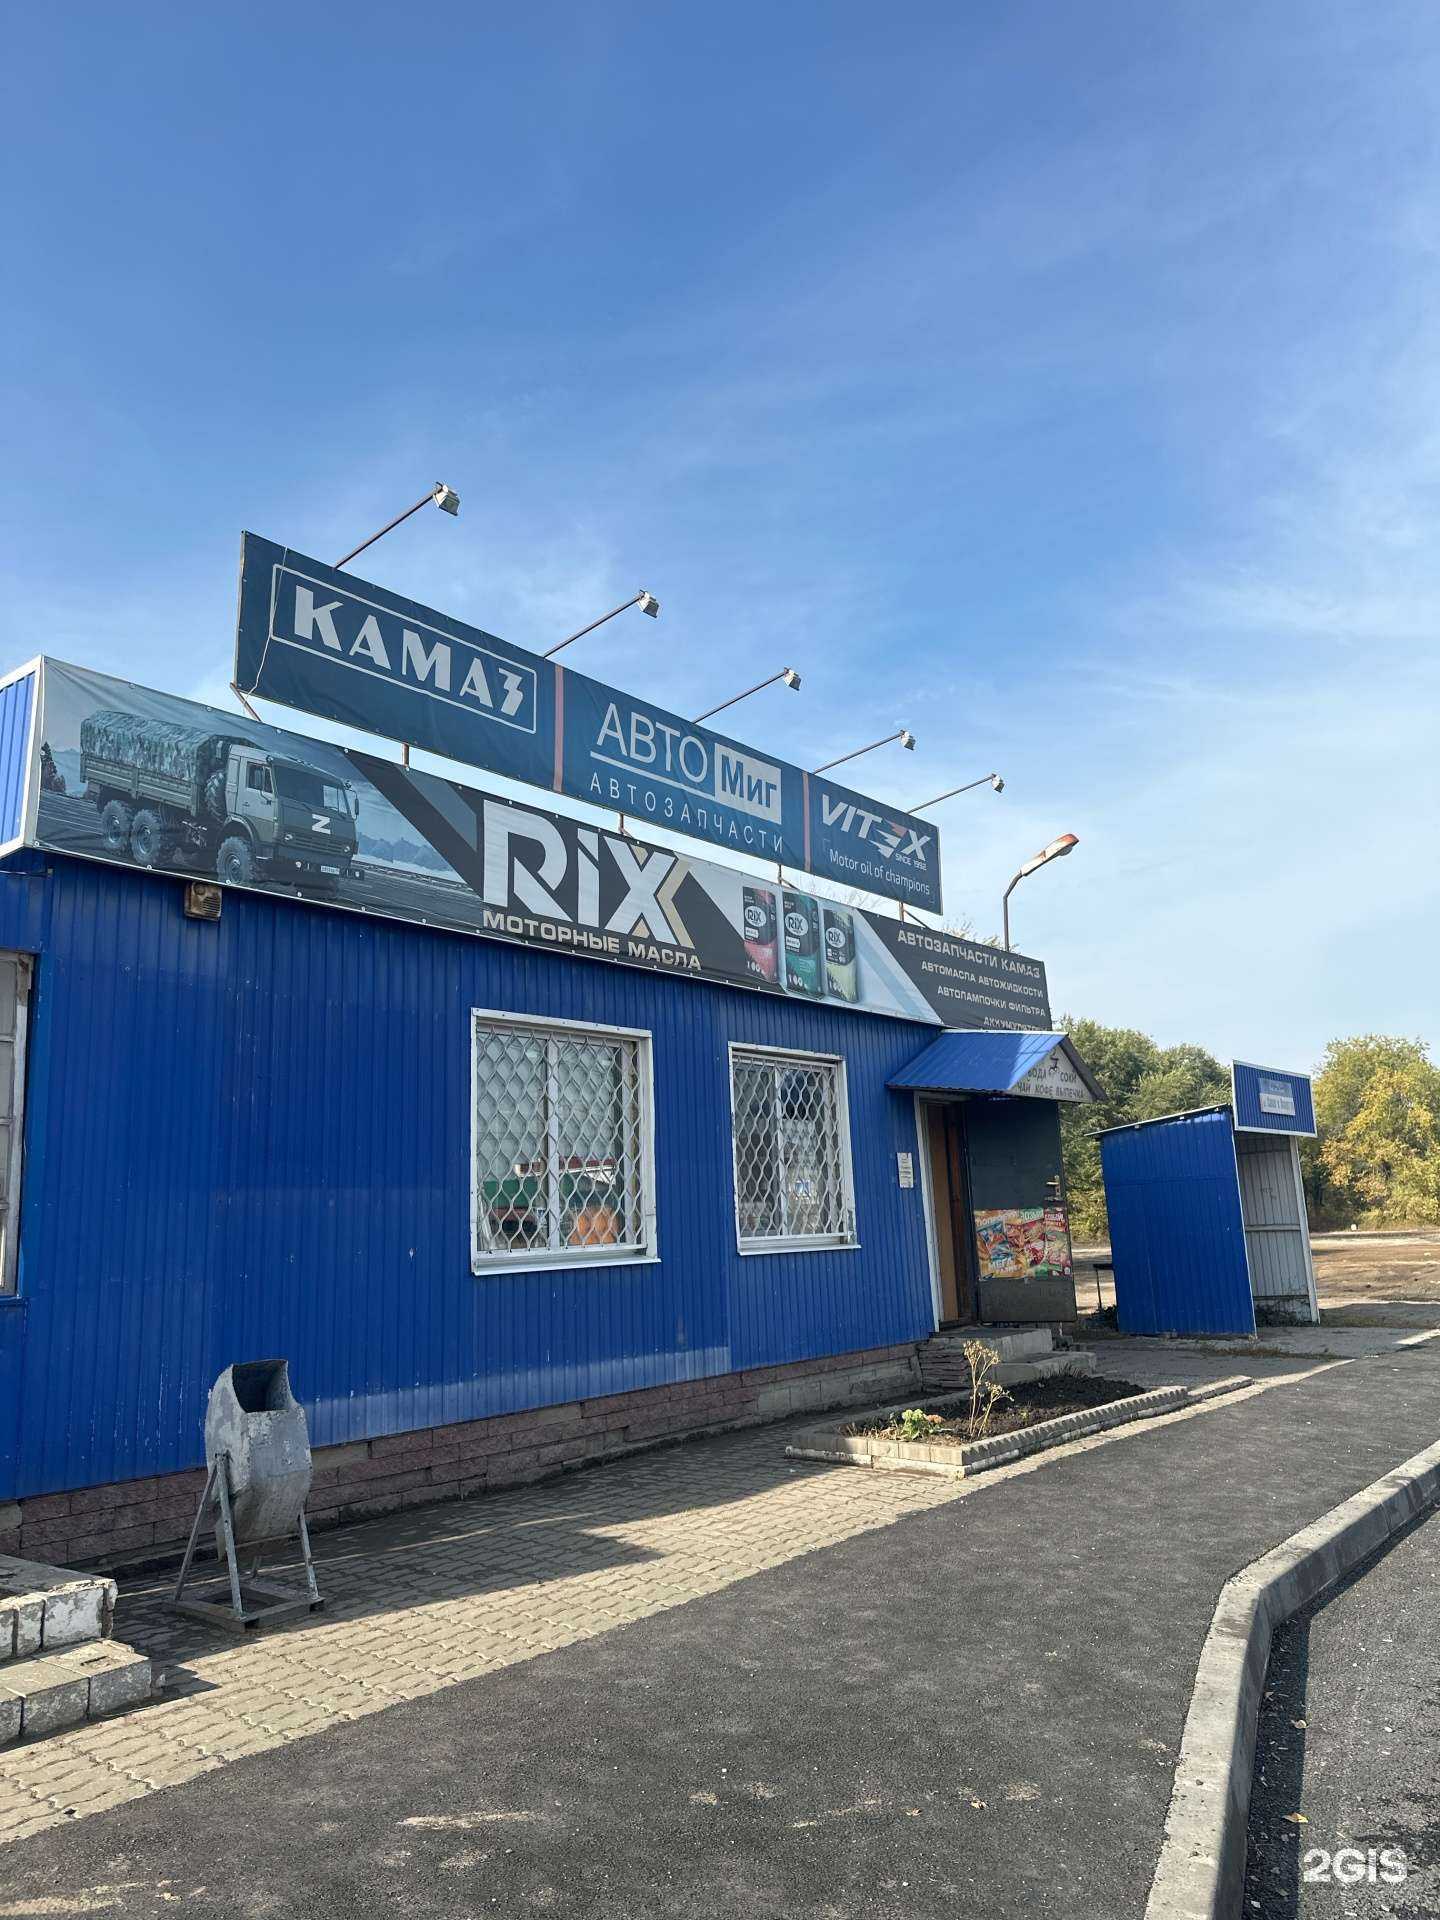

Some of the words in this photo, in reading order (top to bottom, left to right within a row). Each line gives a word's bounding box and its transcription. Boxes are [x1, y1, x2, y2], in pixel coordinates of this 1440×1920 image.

[294, 585, 523, 716] КАМАЗ
[590, 772, 783, 854] АВТОЗАПЧАСТИ
[829, 848, 859, 871] Motor
[860, 860, 873, 876] oil
[874, 865, 884, 879] of
[885, 869, 930, 895] champions
[482, 910, 620, 955] МОТОРНЫЕ
[628, 941, 701, 971] МАСЛА
[898, 930, 998, 968] АВТОЗАПЧАСТИ
[1001, 958, 1041, 978] КАМАЗ
[921, 961, 976, 982] АВТОМАСЛА
[979, 975, 1044, 998] АВТОЖИДКОСТИ
[937, 985, 1007, 1009] АВТОЛАМПОЧКИ
[1009, 1001, 1046, 1017] ФИЛЬТРА
